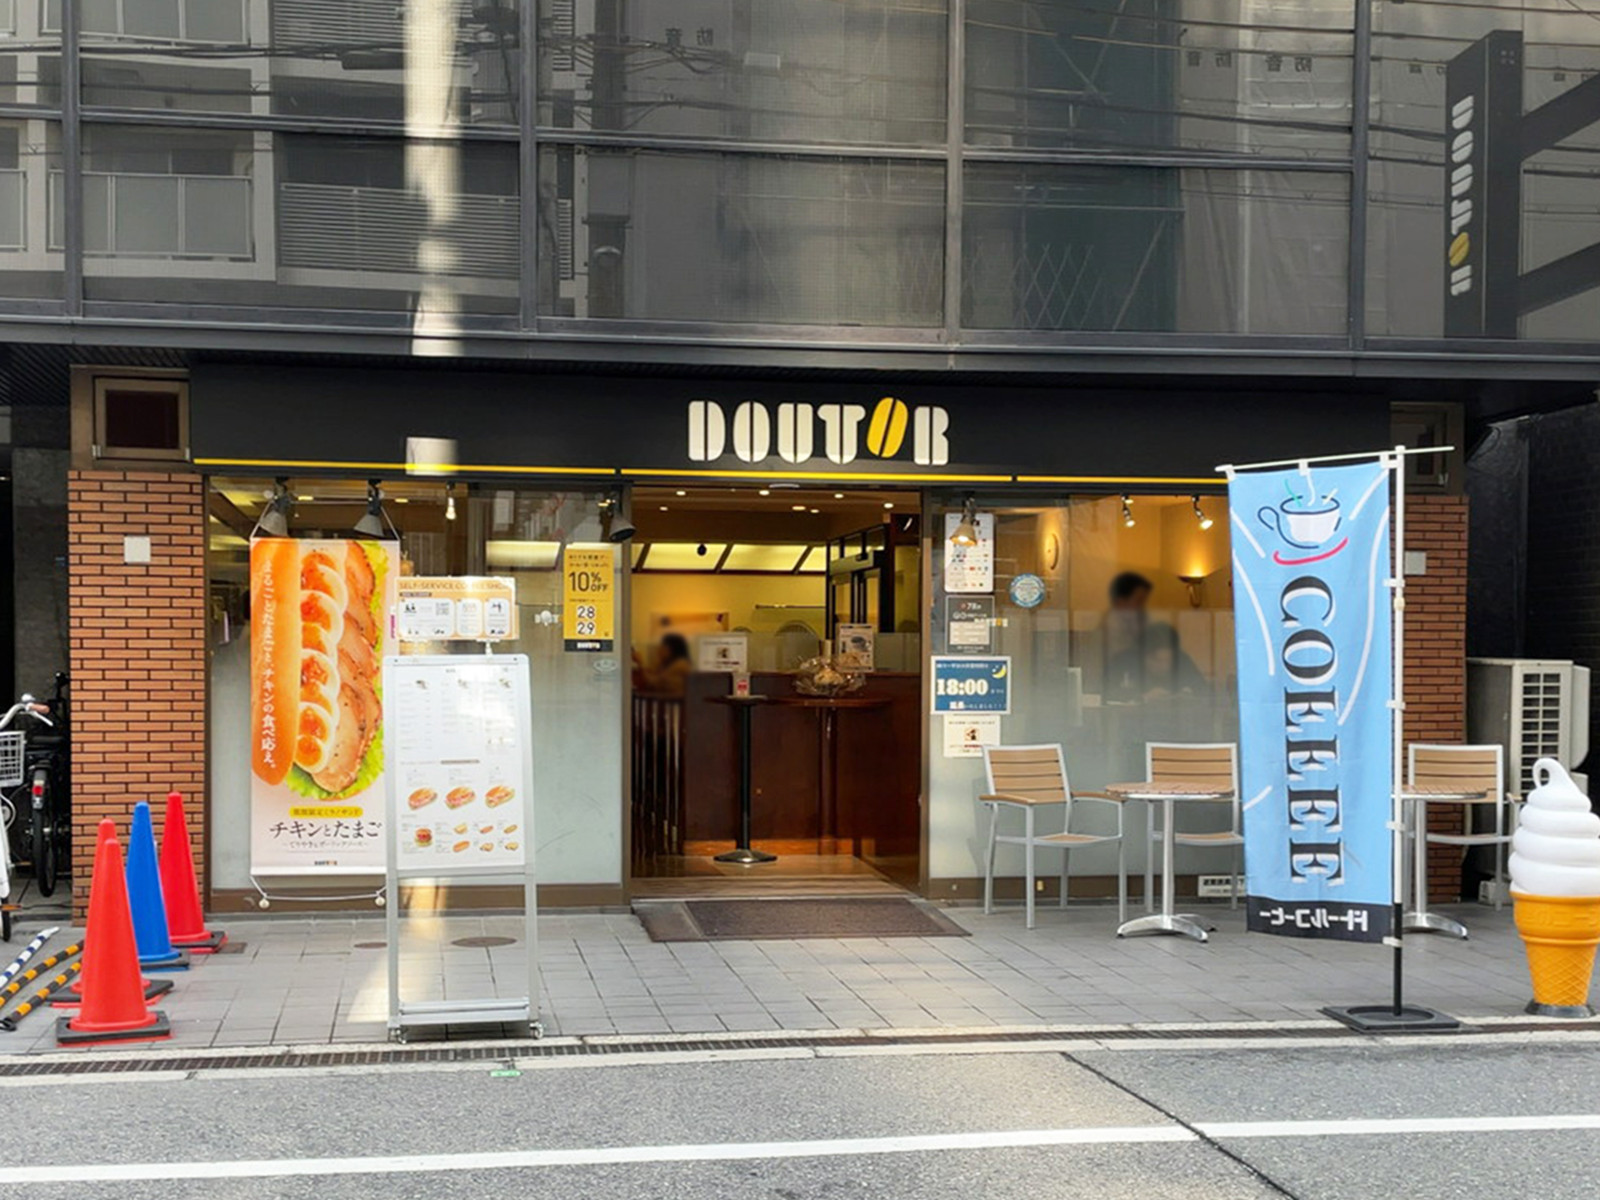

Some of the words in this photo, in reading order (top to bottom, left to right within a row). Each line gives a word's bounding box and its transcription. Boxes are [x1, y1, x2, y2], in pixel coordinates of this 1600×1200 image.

[688, 397, 949, 466] DOUTOR
[590, 583, 609, 592] OFF
[576, 605, 596, 619] 28
[576, 621, 596, 635] 29
[936, 678, 989, 696] 18:00
[269, 820, 382, 839] チキンとたまご
